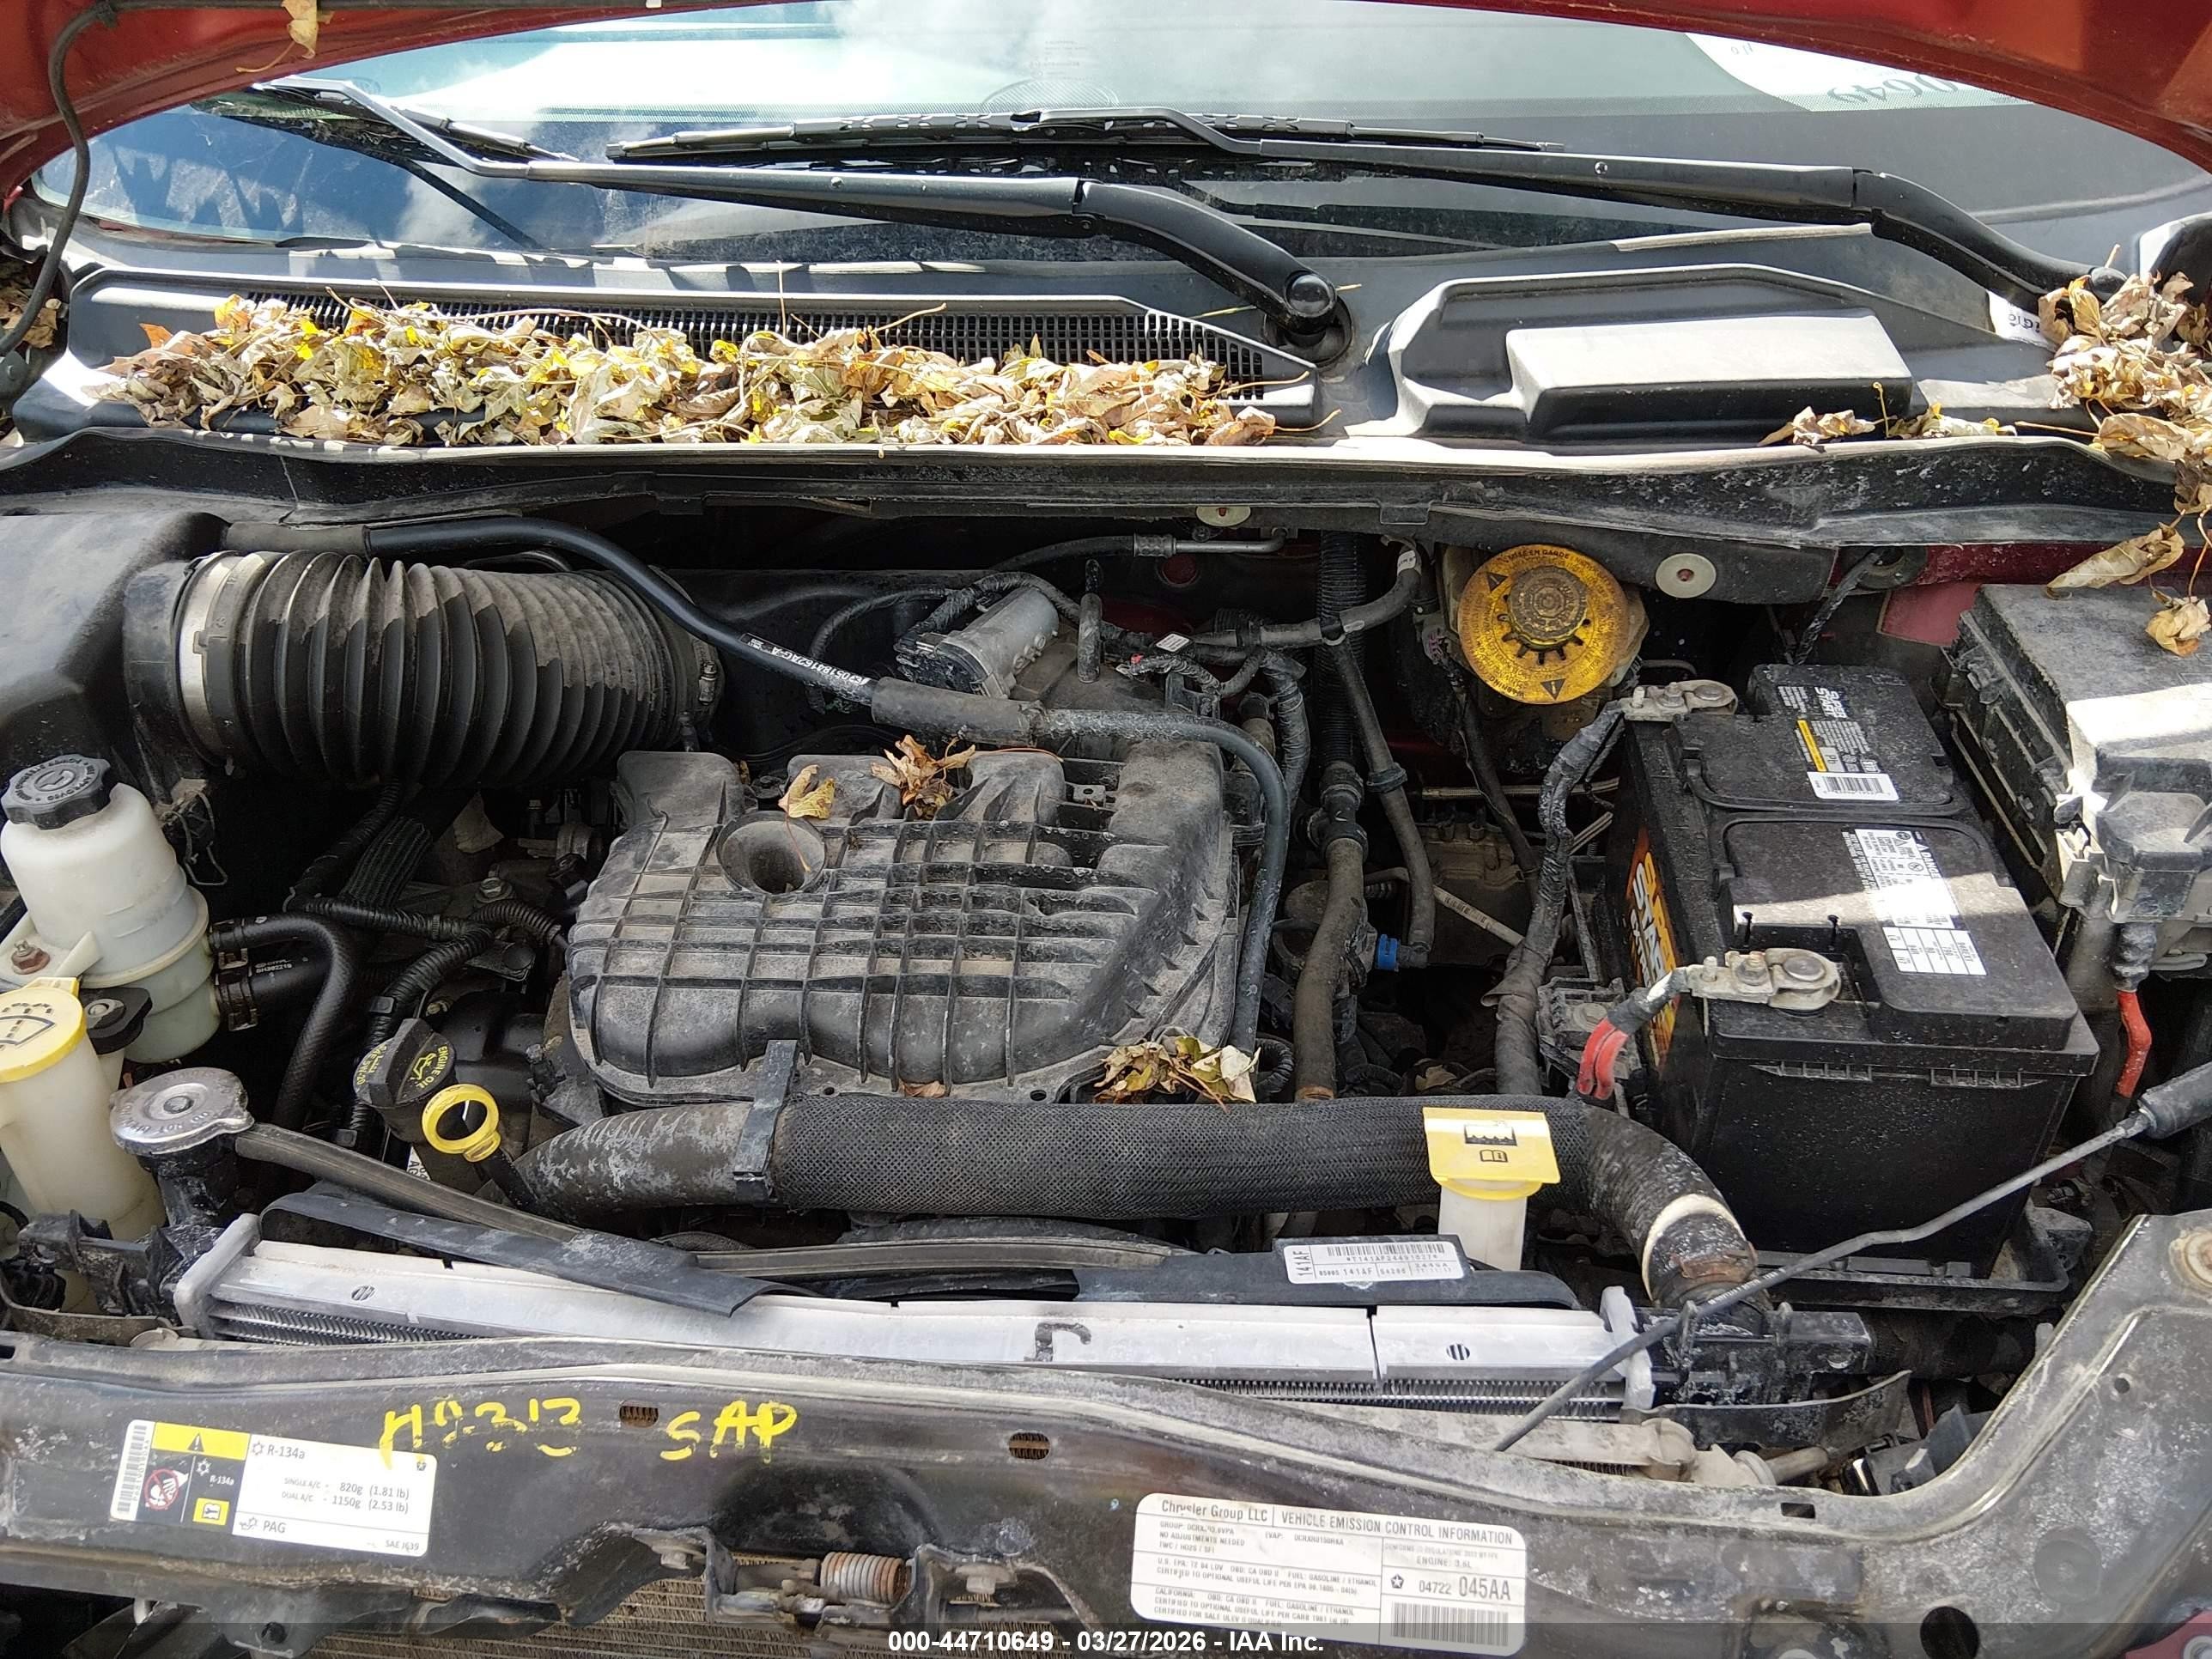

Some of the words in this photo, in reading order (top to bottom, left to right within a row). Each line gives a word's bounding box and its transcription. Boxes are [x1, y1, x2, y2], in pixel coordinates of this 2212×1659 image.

[1814, 687, 1839, 719] START
[1829, 690, 1847, 719] SUPER
[1829, 753, 1838, 765] Pb
[1292, 1251, 1313, 1276] 141AF
[1344, 1267, 1372, 1276] 141AF
[268, 1444, 306, 1459] R-134a
[210, 1474, 234, 1486] R-134a
[308, 1480, 321, 1489] A/C
[339, 1482, 364, 1496] 820g
[369, 1485, 393, 1498] (1.81
[397, 1487, 410, 1500] lb)
[282, 1491, 299, 1500] DUAL
[300, 1492, 313, 1502] A/C
[332, 1495, 361, 1509] 1150g
[368, 1498, 392, 1511] (2.53
[396, 1502, 409, 1514] lb)
[1211, 1504, 1243, 1521] Group
[1248, 1508, 1267, 1522] LLC
[263, 1520, 286, 1534] PAG
[1282, 1510, 1326, 1528] VEHICLE
[1330, 1516, 1381, 1533] EMISSION
[1385, 1521, 1433, 1537] CONTROL
[1438, 1526, 1512, 1545] INFORMATION
[386, 1540, 399, 1548] SAE
[1171, 1532, 1217, 1544] ADJUSTMENTS
[1220, 1538, 1245, 1547] NEEDED
[1157, 1567, 1189, 1578] CERTIFIED
[1203, 1571, 1233, 1581] OPTIONAL
[1237, 1576, 1260, 1585] USEFUL
[1310, 1573, 1340, 1583] GASOLINE
[1348, 1577, 1376, 1587] ETHANOL
[1419, 1580, 1452, 1595] 04722
[1459, 1576, 1511, 1601] 045AA
[1154, 1607, 1187, 1616] CERTIFIED
[1205, 1612, 1219, 1620] SALE
[1155, 1597, 1188, 1607] CERTIFIED
[1200, 1602, 1231, 1612] OPTIONAL
[1235, 1606, 1257, 1615] USEFUL
[1286, 1601, 1317, 1612] GASOLINE
[1326, 1606, 1354, 1615] ETHANOL
